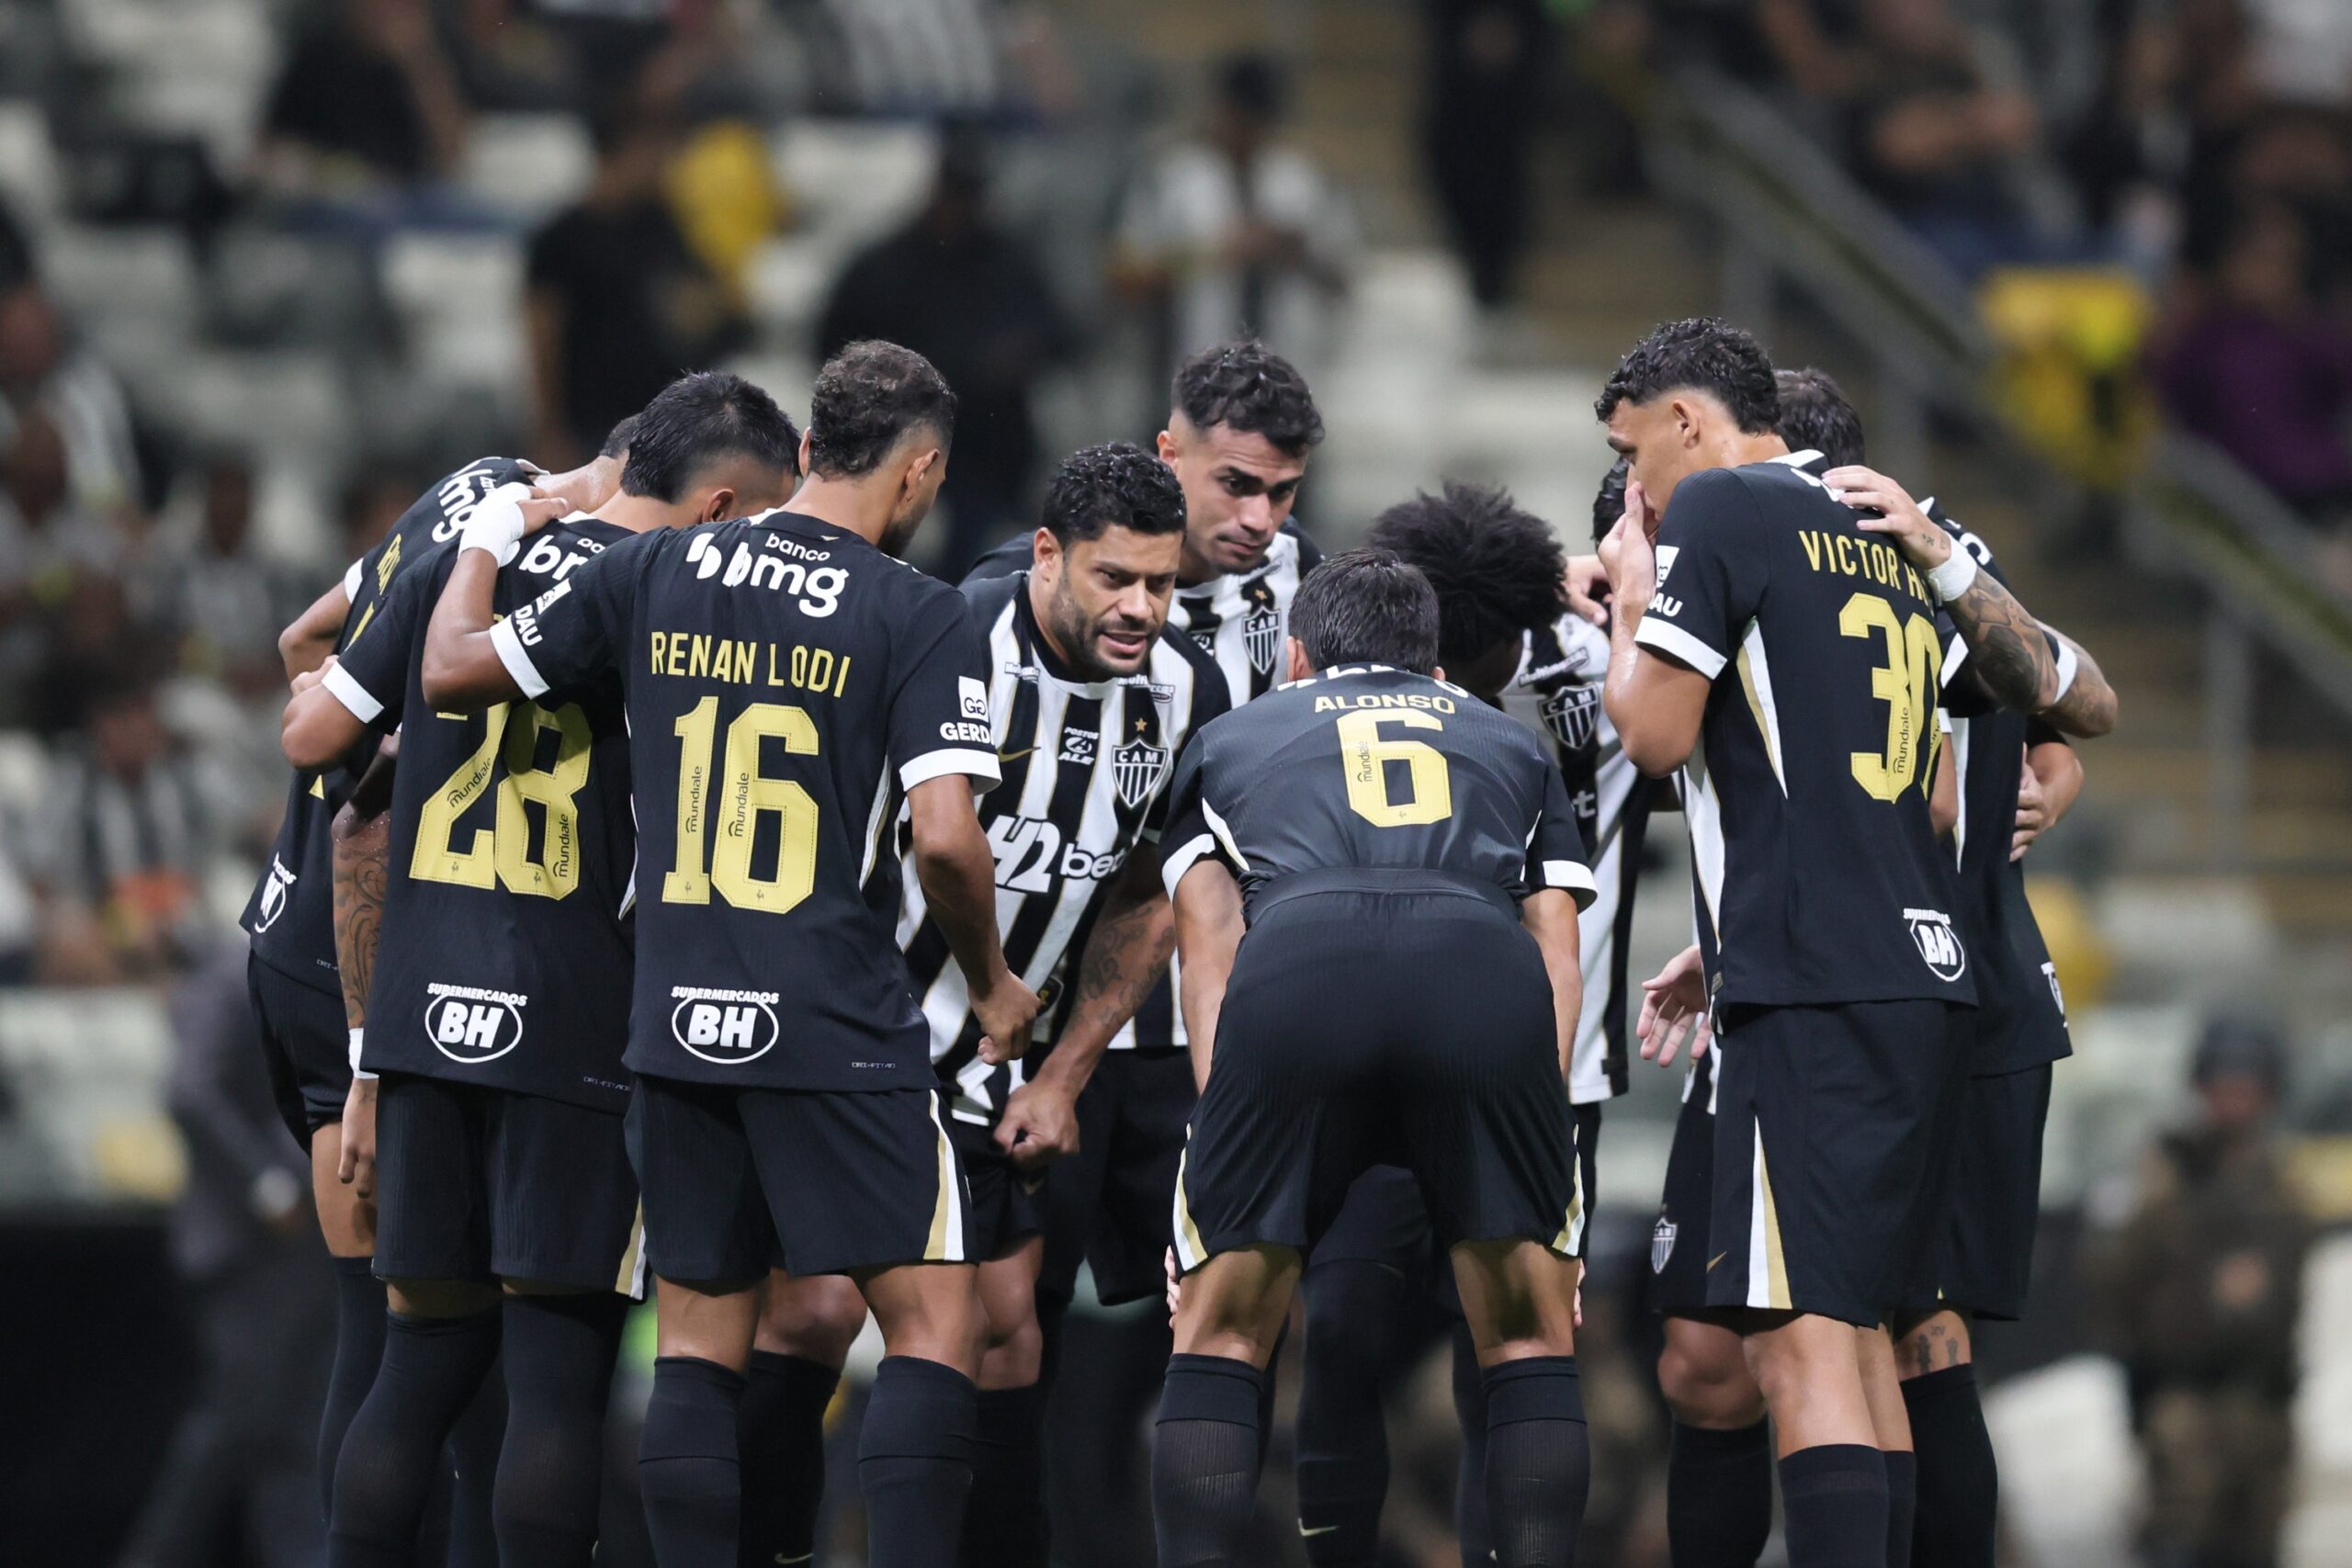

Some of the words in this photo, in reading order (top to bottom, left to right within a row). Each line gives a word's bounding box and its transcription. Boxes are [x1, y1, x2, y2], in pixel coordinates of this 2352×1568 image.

[765, 533, 831, 562] banco
[1798, 530, 1902, 591] VICTOR
[722, 541, 850, 618] bmg
[1247, 615, 1277, 632] CAM
[650, 631, 757, 685] RENAN
[767, 642, 851, 698] LODI
[1314, 694, 1455, 715] ALONSO
[1547, 690, 1591, 715] CAM
[1838, 592, 1943, 805] 30
[940, 721, 995, 746] GERD
[1064, 727, 1100, 740] POSTOS
[1118, 750, 1159, 764] CAM
[1894, 707, 1910, 774] mundiale
[1057, 751, 1095, 766] ALE
[1336, 706, 1453, 828] 6
[409, 702, 593, 901] 28
[662, 695, 819, 915] 16
[687, 766, 703, 833] mundiale
[730, 773, 750, 838] mundiale
[555, 814, 570, 878] mundiale
[1917, 924, 1957, 966] BH
[426, 982, 528, 1007] SUPERMERCADOS
[671, 986, 780, 1005] SUPERMERCADOS
[437, 1001, 505, 1049] BH
[687, 1003, 758, 1049] BH
